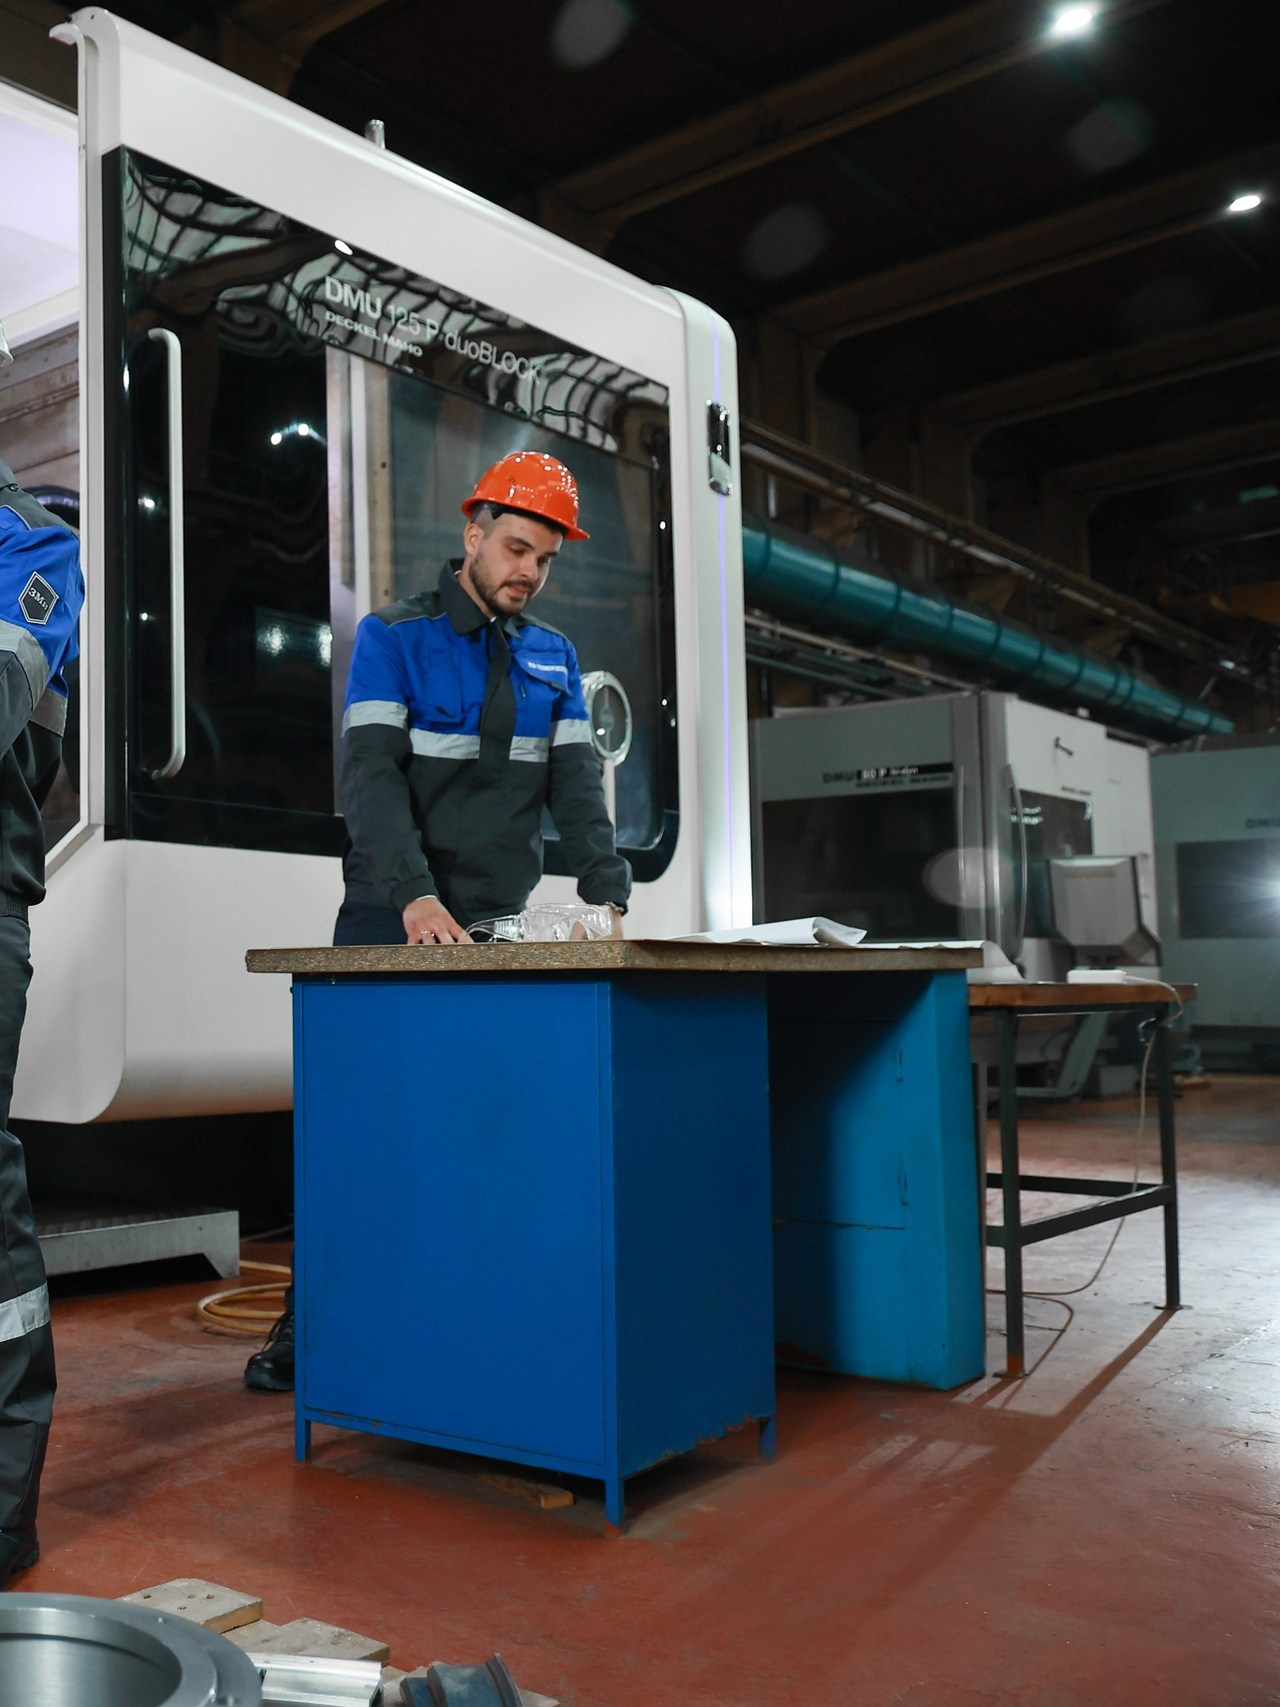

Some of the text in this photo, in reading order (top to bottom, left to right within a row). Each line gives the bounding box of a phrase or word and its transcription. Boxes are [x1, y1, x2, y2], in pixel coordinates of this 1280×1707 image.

[325, 276, 540, 385] DMU 125 P duoBLOCK
[325, 310, 423, 358] DECKEL MAHO
